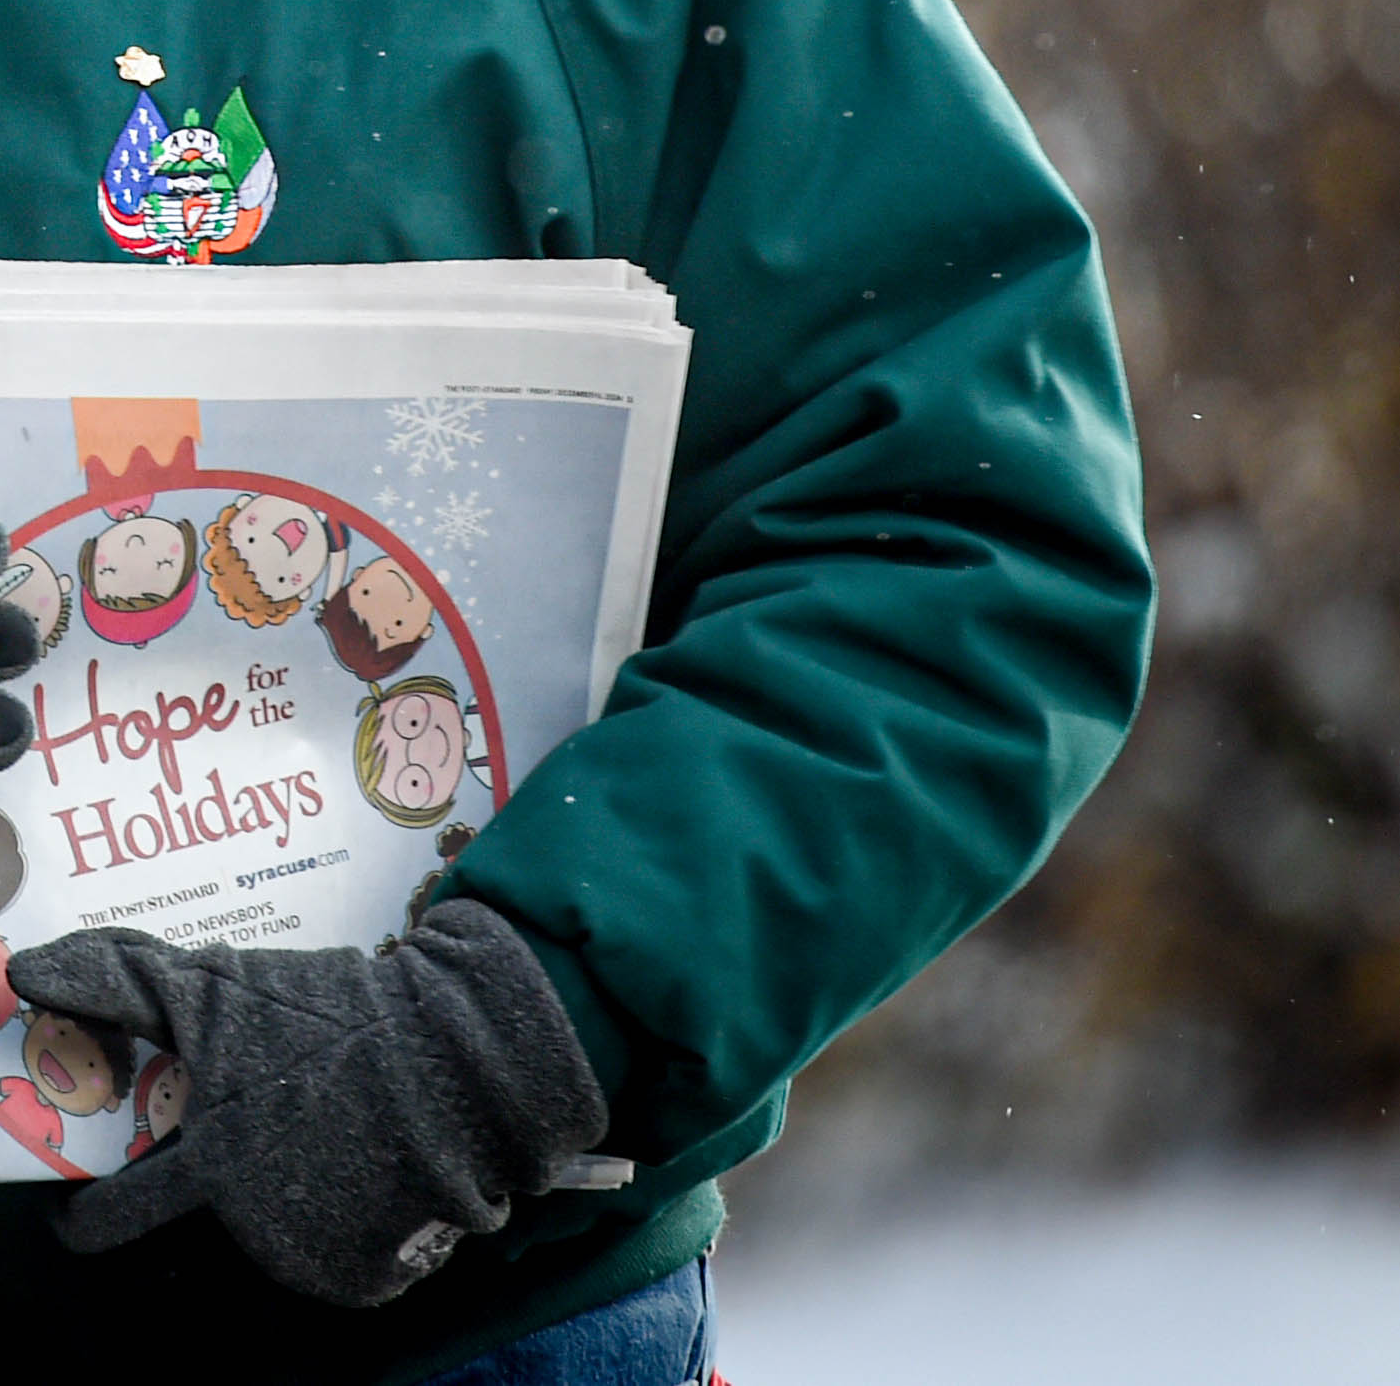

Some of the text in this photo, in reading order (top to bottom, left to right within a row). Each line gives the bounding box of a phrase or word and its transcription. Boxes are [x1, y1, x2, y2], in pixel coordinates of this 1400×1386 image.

[169, 129, 212, 148] AOH
[246, 663, 290, 693] for
[29, 658, 241, 795] Hope
[250, 694, 295, 728] the
[50, 768, 324, 878] Holidays
[79, 882, 220, 928] THE POST-STANDARD
[163, 901, 276, 942] OLD NEWSBOYS
[229, 925, 259, 944] TOY
[261, 914, 302, 937] FUND
